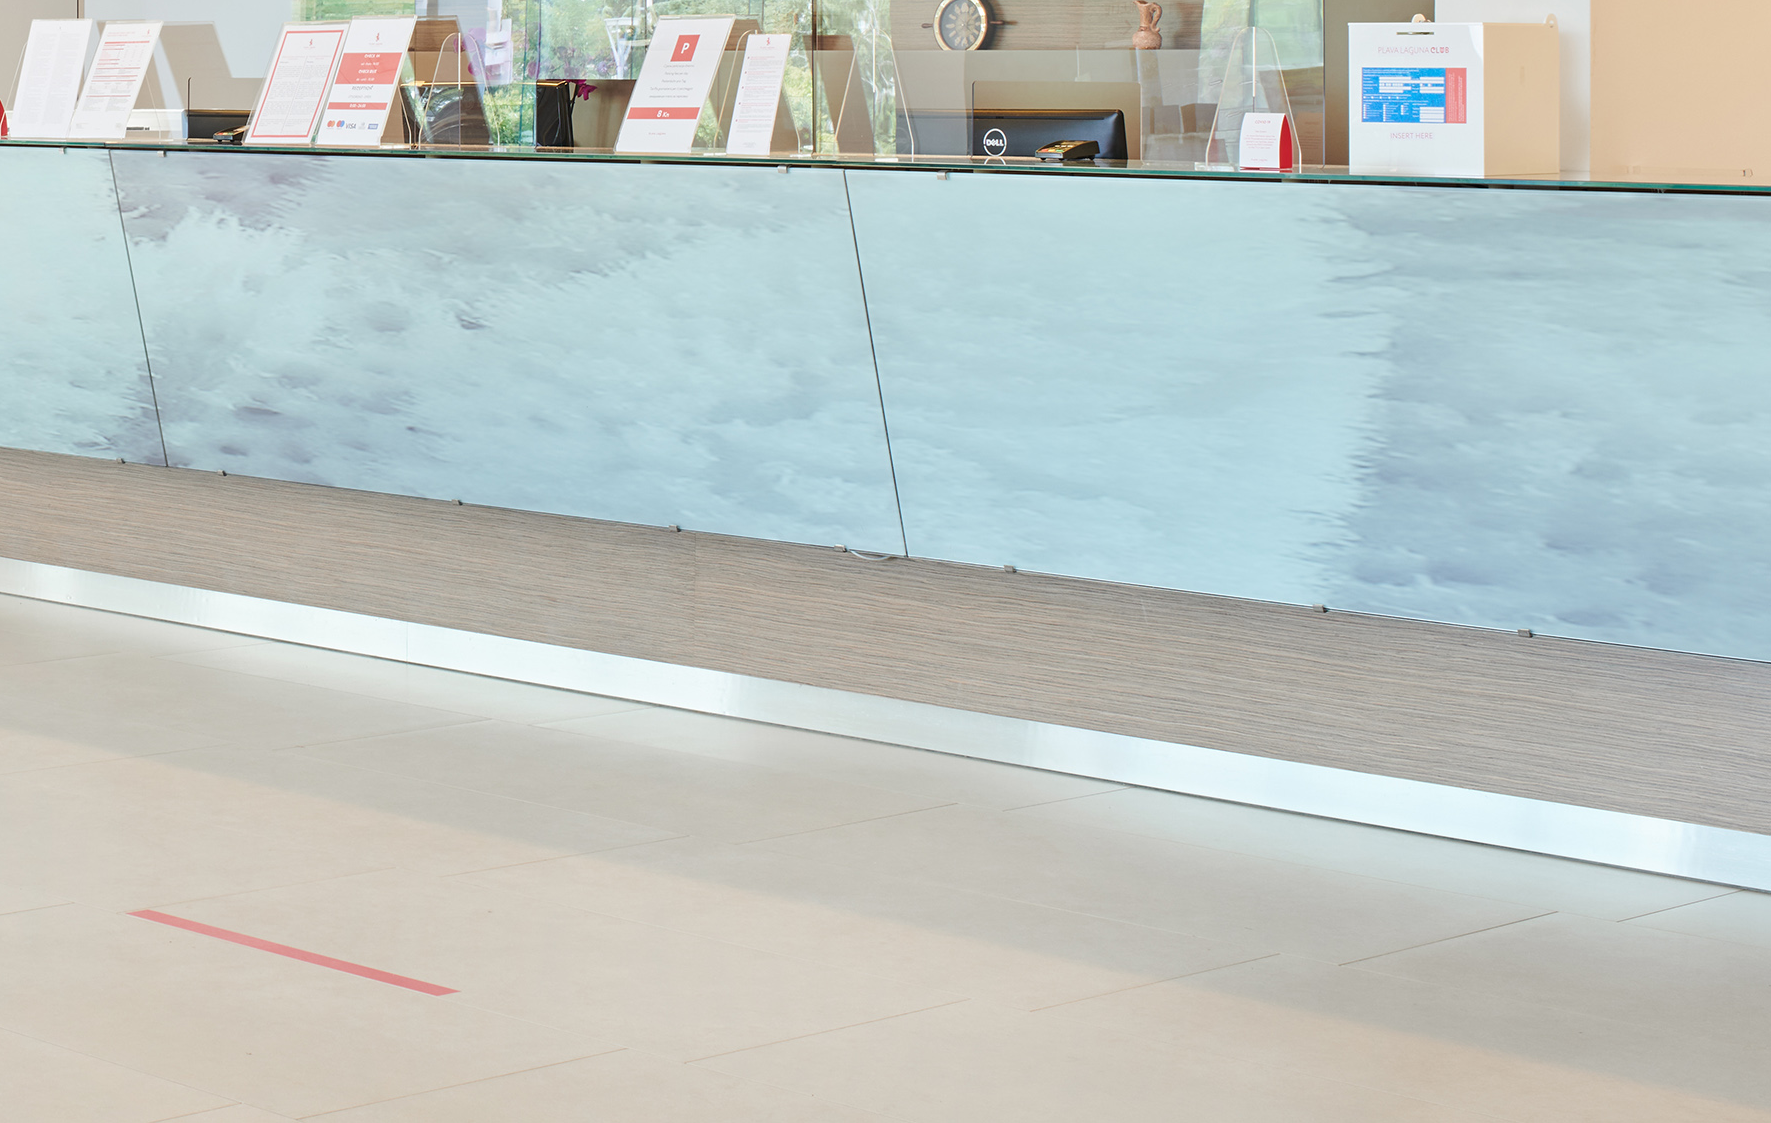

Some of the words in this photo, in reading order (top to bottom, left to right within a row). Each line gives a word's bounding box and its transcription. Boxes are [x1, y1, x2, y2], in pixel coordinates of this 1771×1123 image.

[681, 43, 690, 54] P
[1377, 46, 1399, 54] PLAVA
[1400, 46, 1430, 55] LAGUNA
[1430, 46, 1450, 54] CLUB
[1390, 132, 1414, 140] INSERT
[1415, 132, 1433, 140] HERE
[985, 138, 1004, 147] DELL
